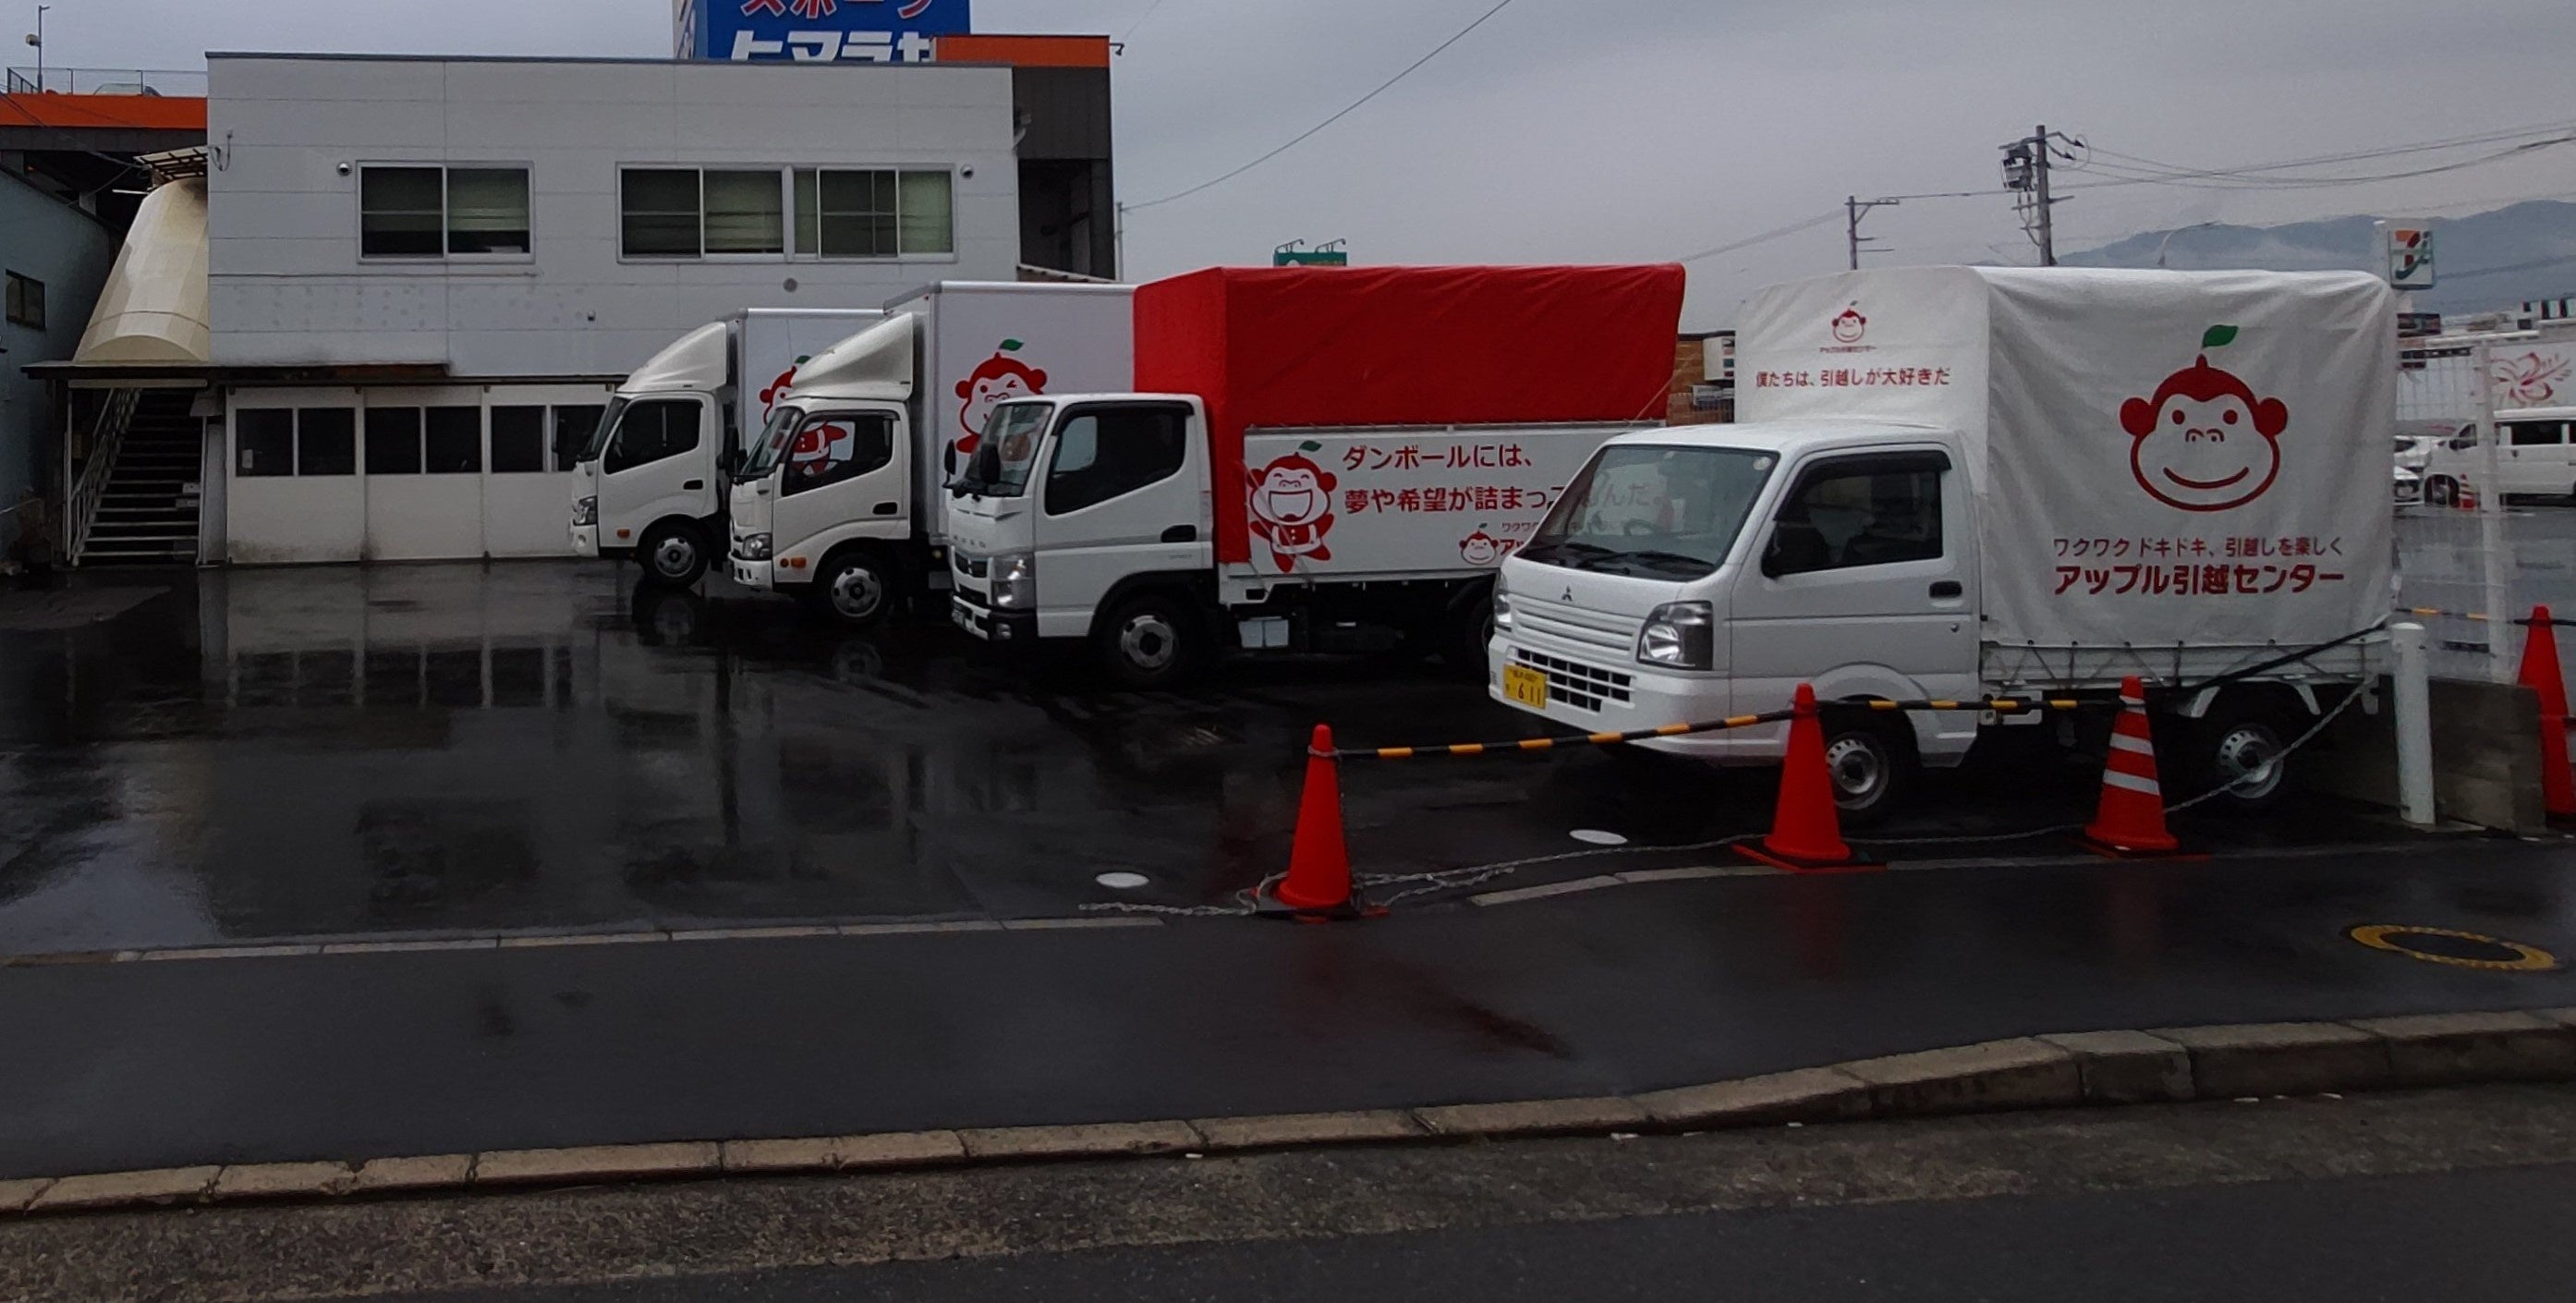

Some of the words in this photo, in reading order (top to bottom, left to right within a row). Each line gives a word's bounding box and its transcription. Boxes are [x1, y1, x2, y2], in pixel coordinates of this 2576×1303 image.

[1755, 367, 1951, 388] 僕たちは、引越しが大好きだ
[1342, 444, 1533, 471] ダンボールには、
[2052, 538, 2131, 558] ワクワク
[2054, 563, 2345, 596] アップル引越センター
